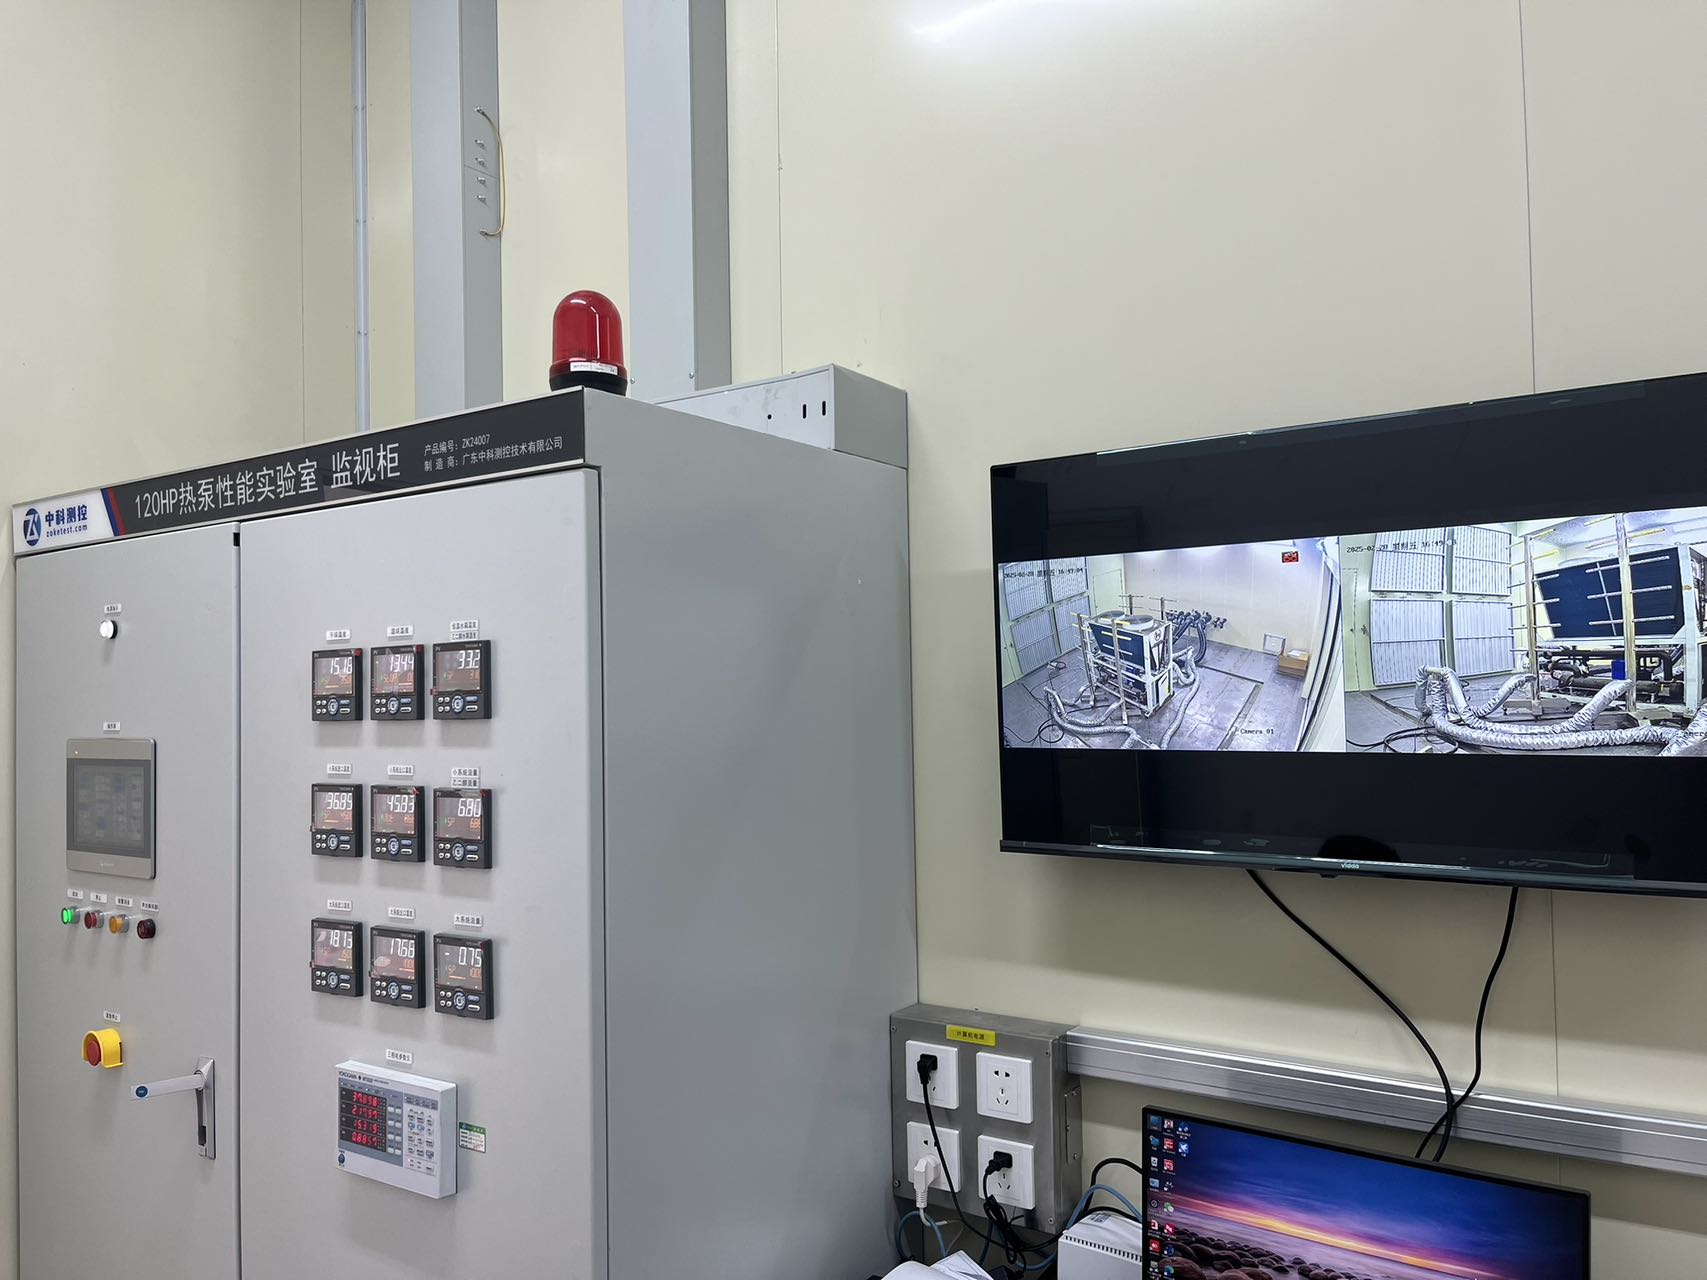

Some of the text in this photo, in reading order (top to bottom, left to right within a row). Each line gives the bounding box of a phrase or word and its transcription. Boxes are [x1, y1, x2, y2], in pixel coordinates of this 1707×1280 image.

[135, 443, 401, 519] 120HP热泵性能实验室 监视柜
[45, 504, 88, 527] 中科测控
[46, 525, 88, 537] zoketest.com
